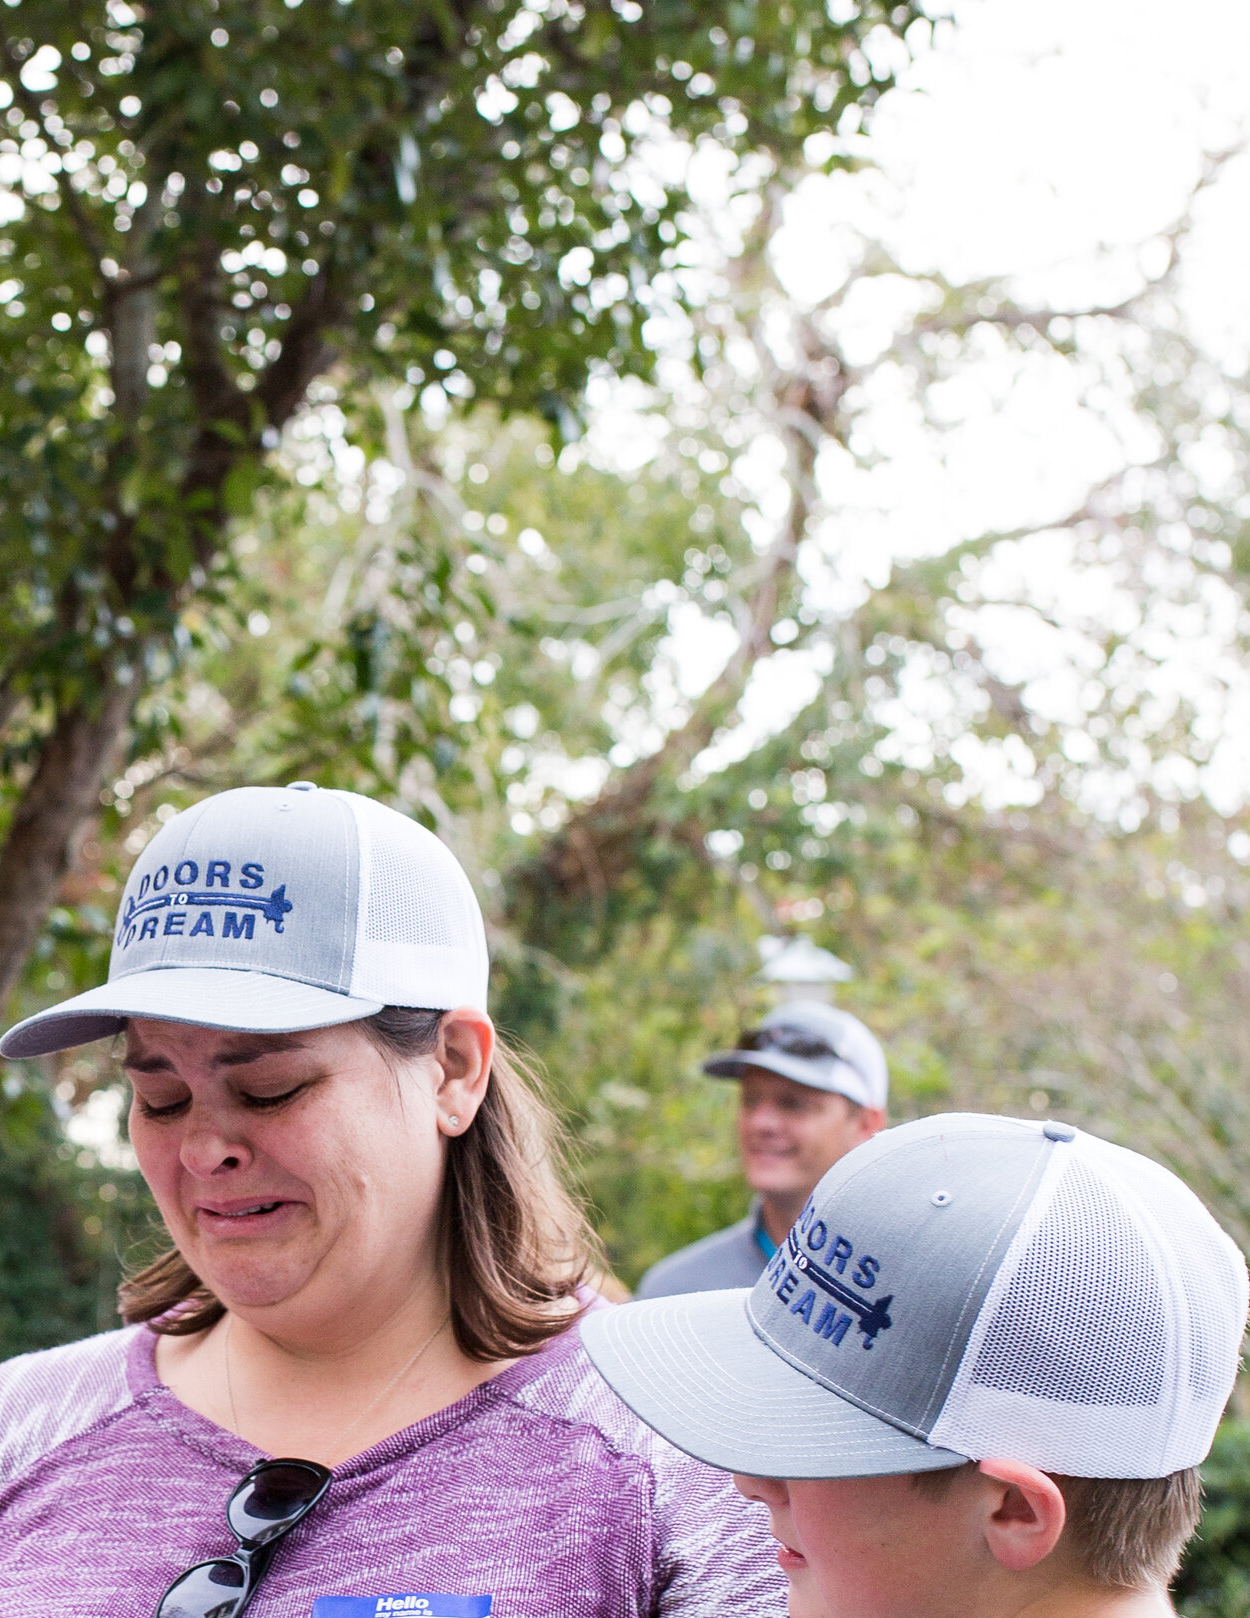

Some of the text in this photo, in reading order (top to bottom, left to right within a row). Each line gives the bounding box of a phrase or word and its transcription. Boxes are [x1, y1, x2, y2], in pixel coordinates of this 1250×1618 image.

[139, 860, 265, 899] DOORS
[169, 893, 189, 906] TO
[123, 911, 256, 949] DREAM
[793, 1249, 808, 1270] TO
[375, 1595, 430, 1612] Hello
[392, 1609, 422, 1617] name
